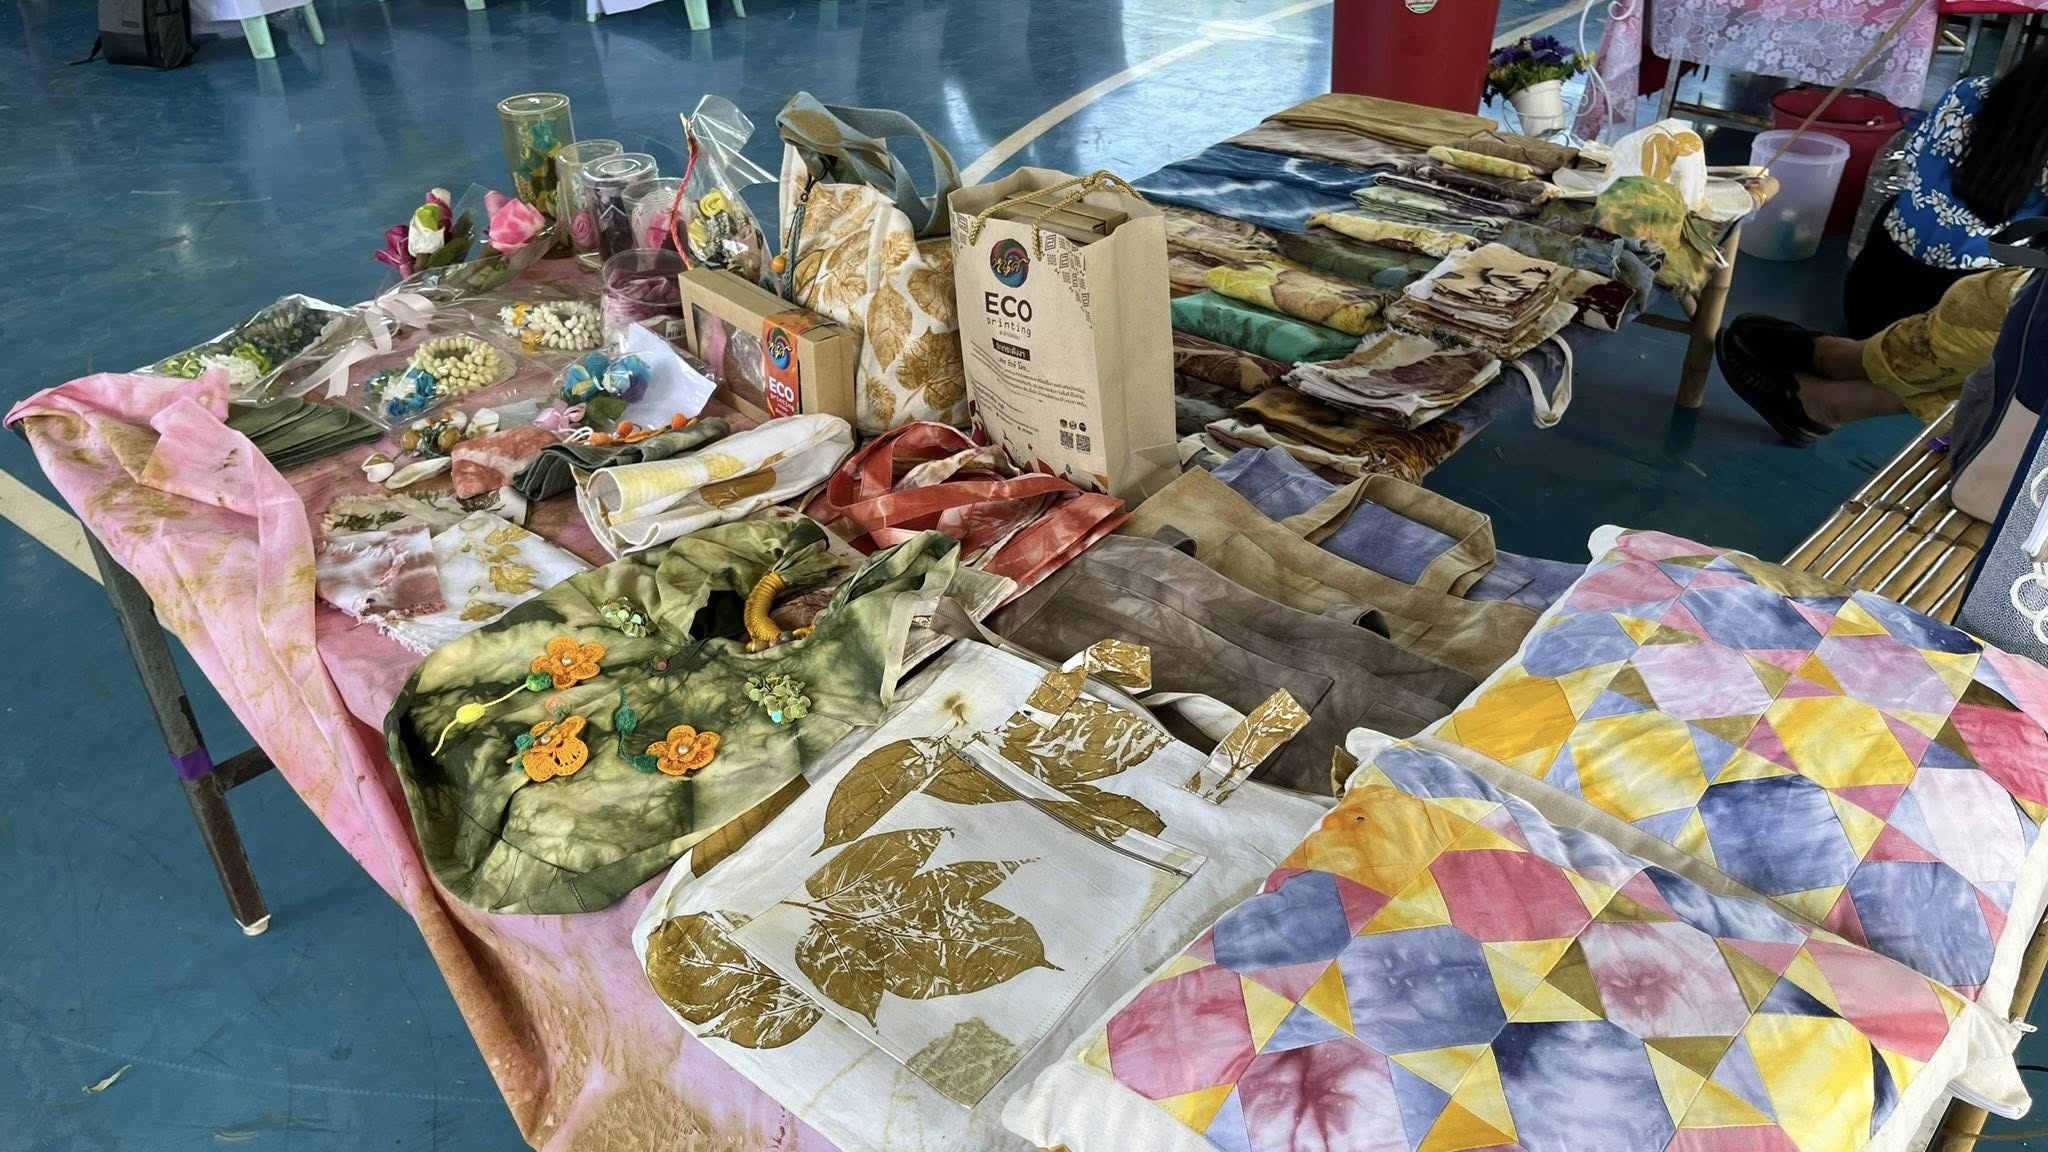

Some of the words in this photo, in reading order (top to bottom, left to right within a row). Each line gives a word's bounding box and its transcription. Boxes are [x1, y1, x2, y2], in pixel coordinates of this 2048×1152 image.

[985, 292, 1032, 322] ECO
[987, 317, 1031, 337] printing
[769, 376, 794, 402] ECO
